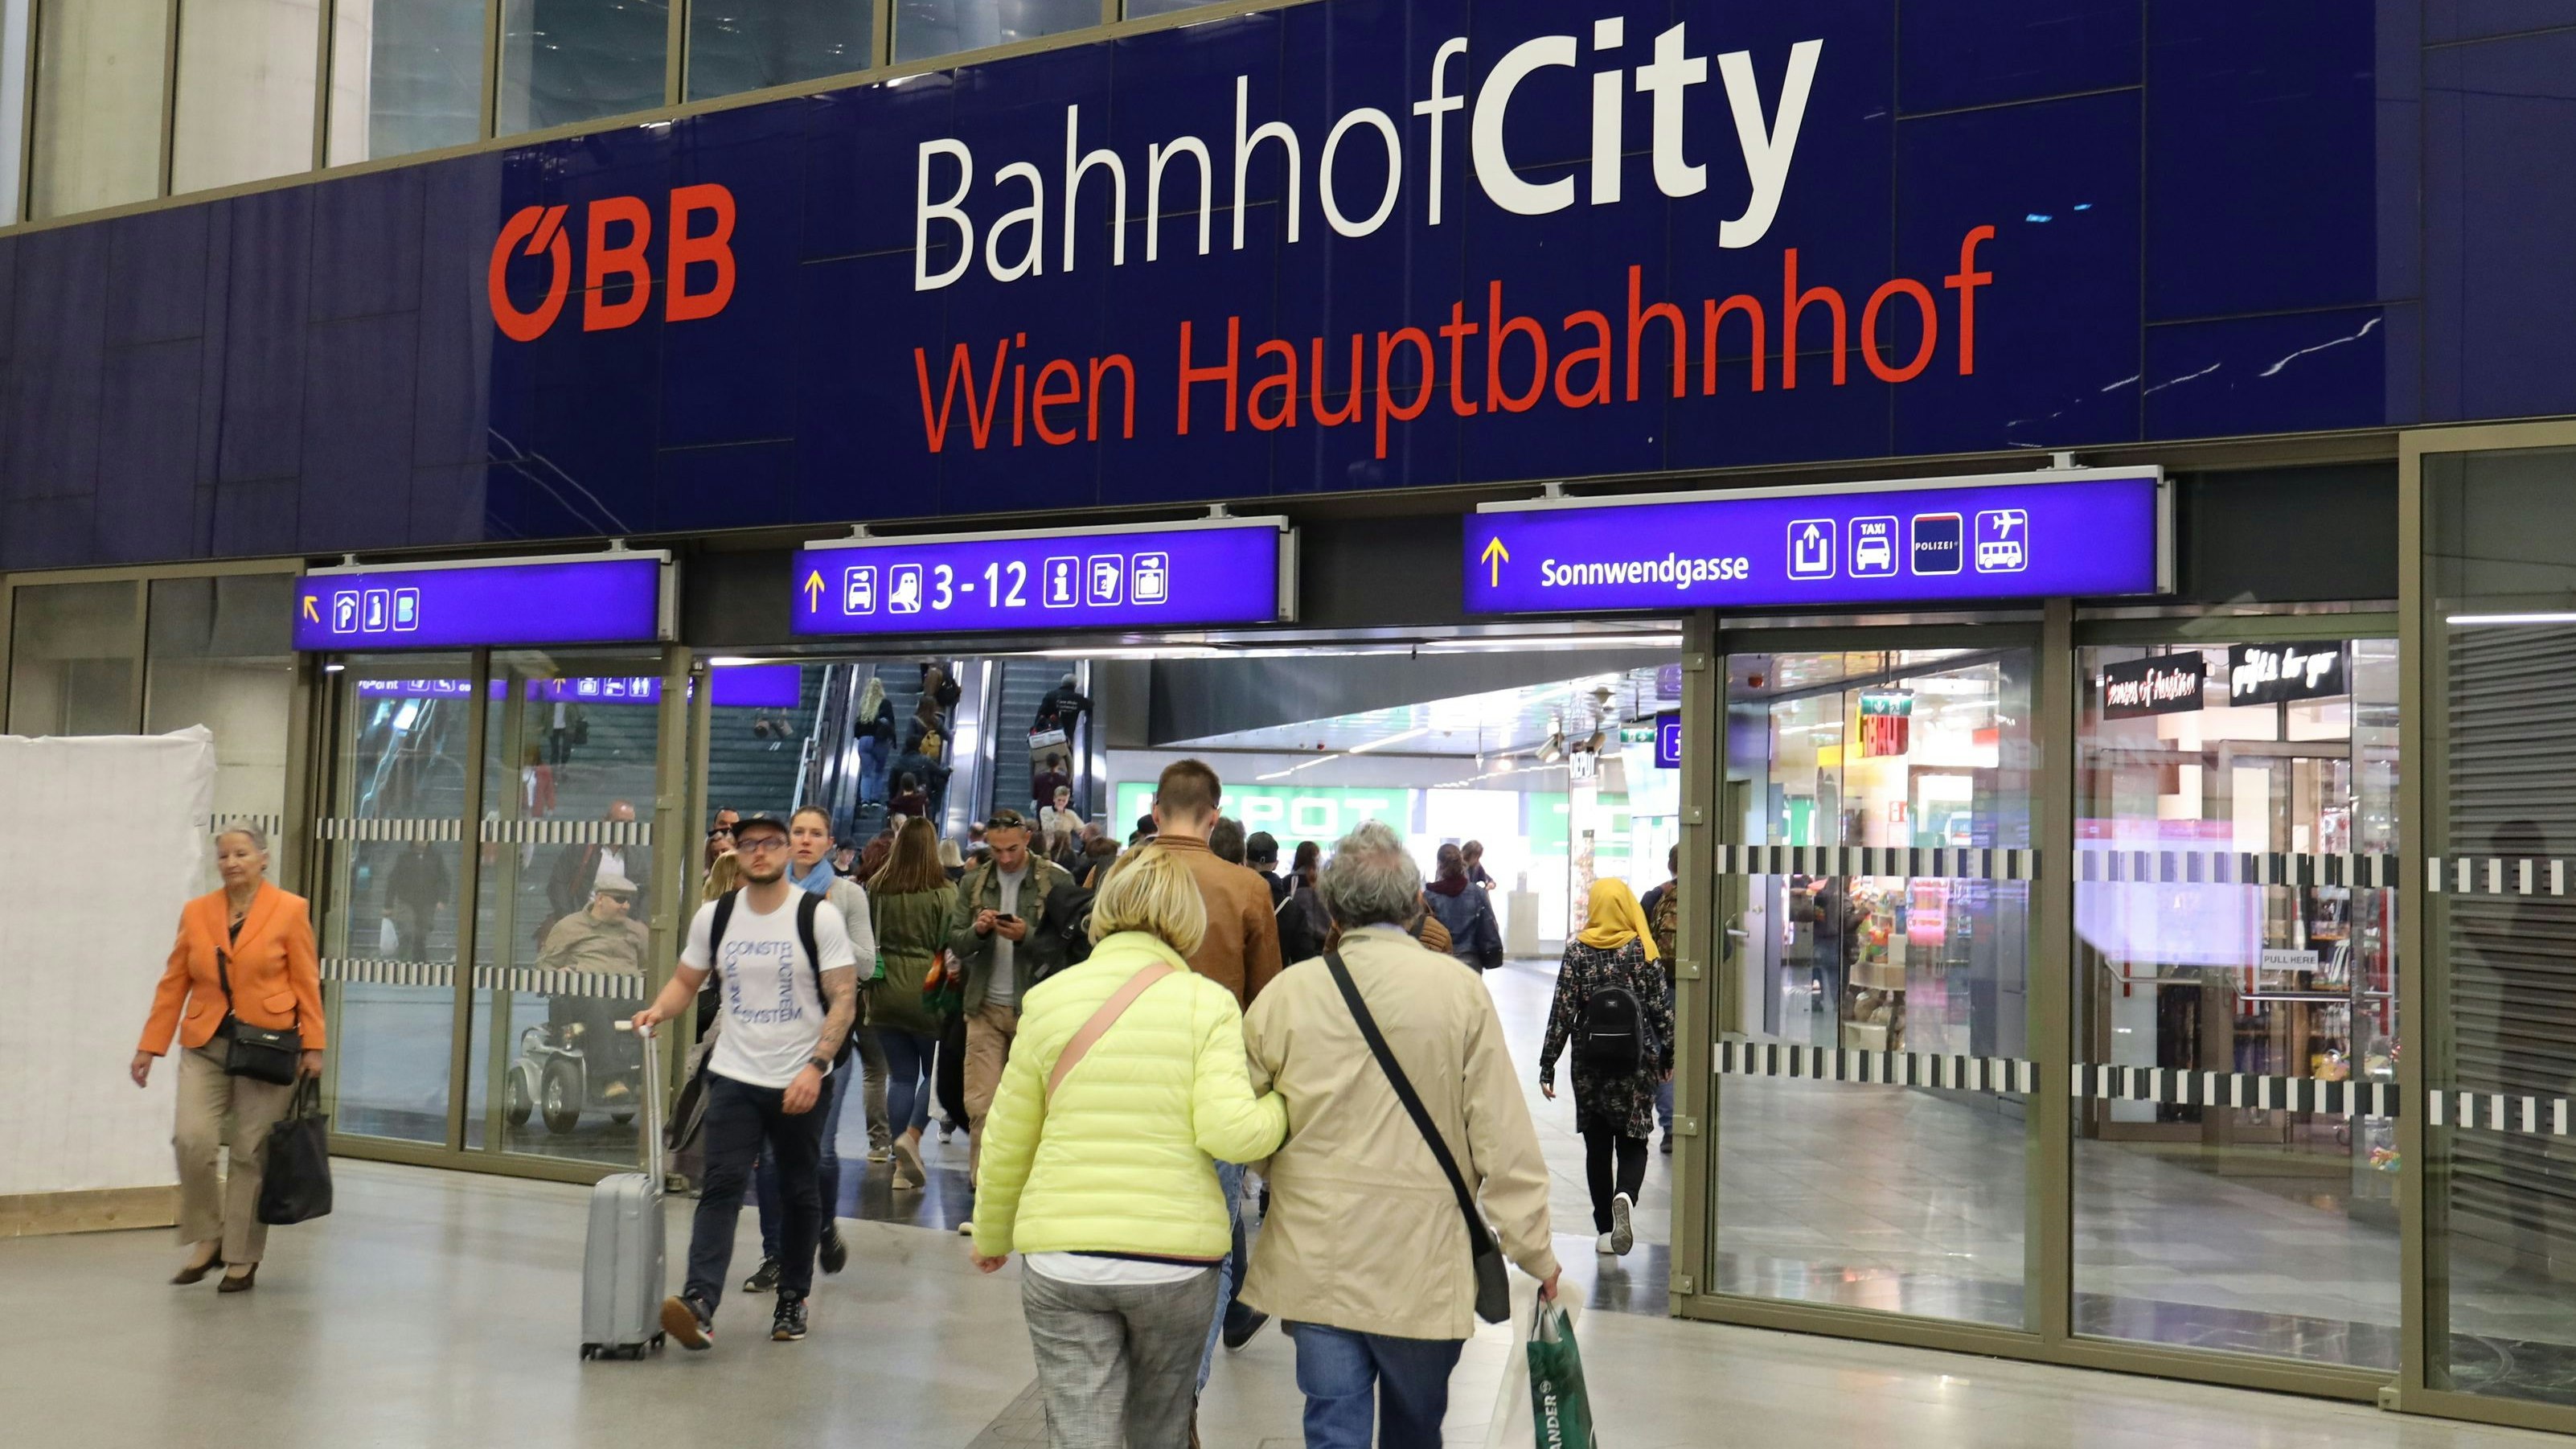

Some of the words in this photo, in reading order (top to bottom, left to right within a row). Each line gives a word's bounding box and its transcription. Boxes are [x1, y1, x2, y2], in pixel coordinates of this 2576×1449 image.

[916, 17, 1823, 290] BahnhofCity
[490, 184, 736, 341] ÖBB
[916, 332, 1134, 451] Wien
[1179, 226, 1995, 458] Hauptbahnhof
[1860, 523, 1886, 536] TAXI
[1915, 540, 1954, 552] POLIZEI
[1541, 552, 1749, 590] Sonnwendgasse
[2139, 667, 2155, 708] of
[2264, 954, 2288, 963] PULL
[2290, 955, 2316, 964] HERE
[740, 1007, 803, 1024] SYSTEM
